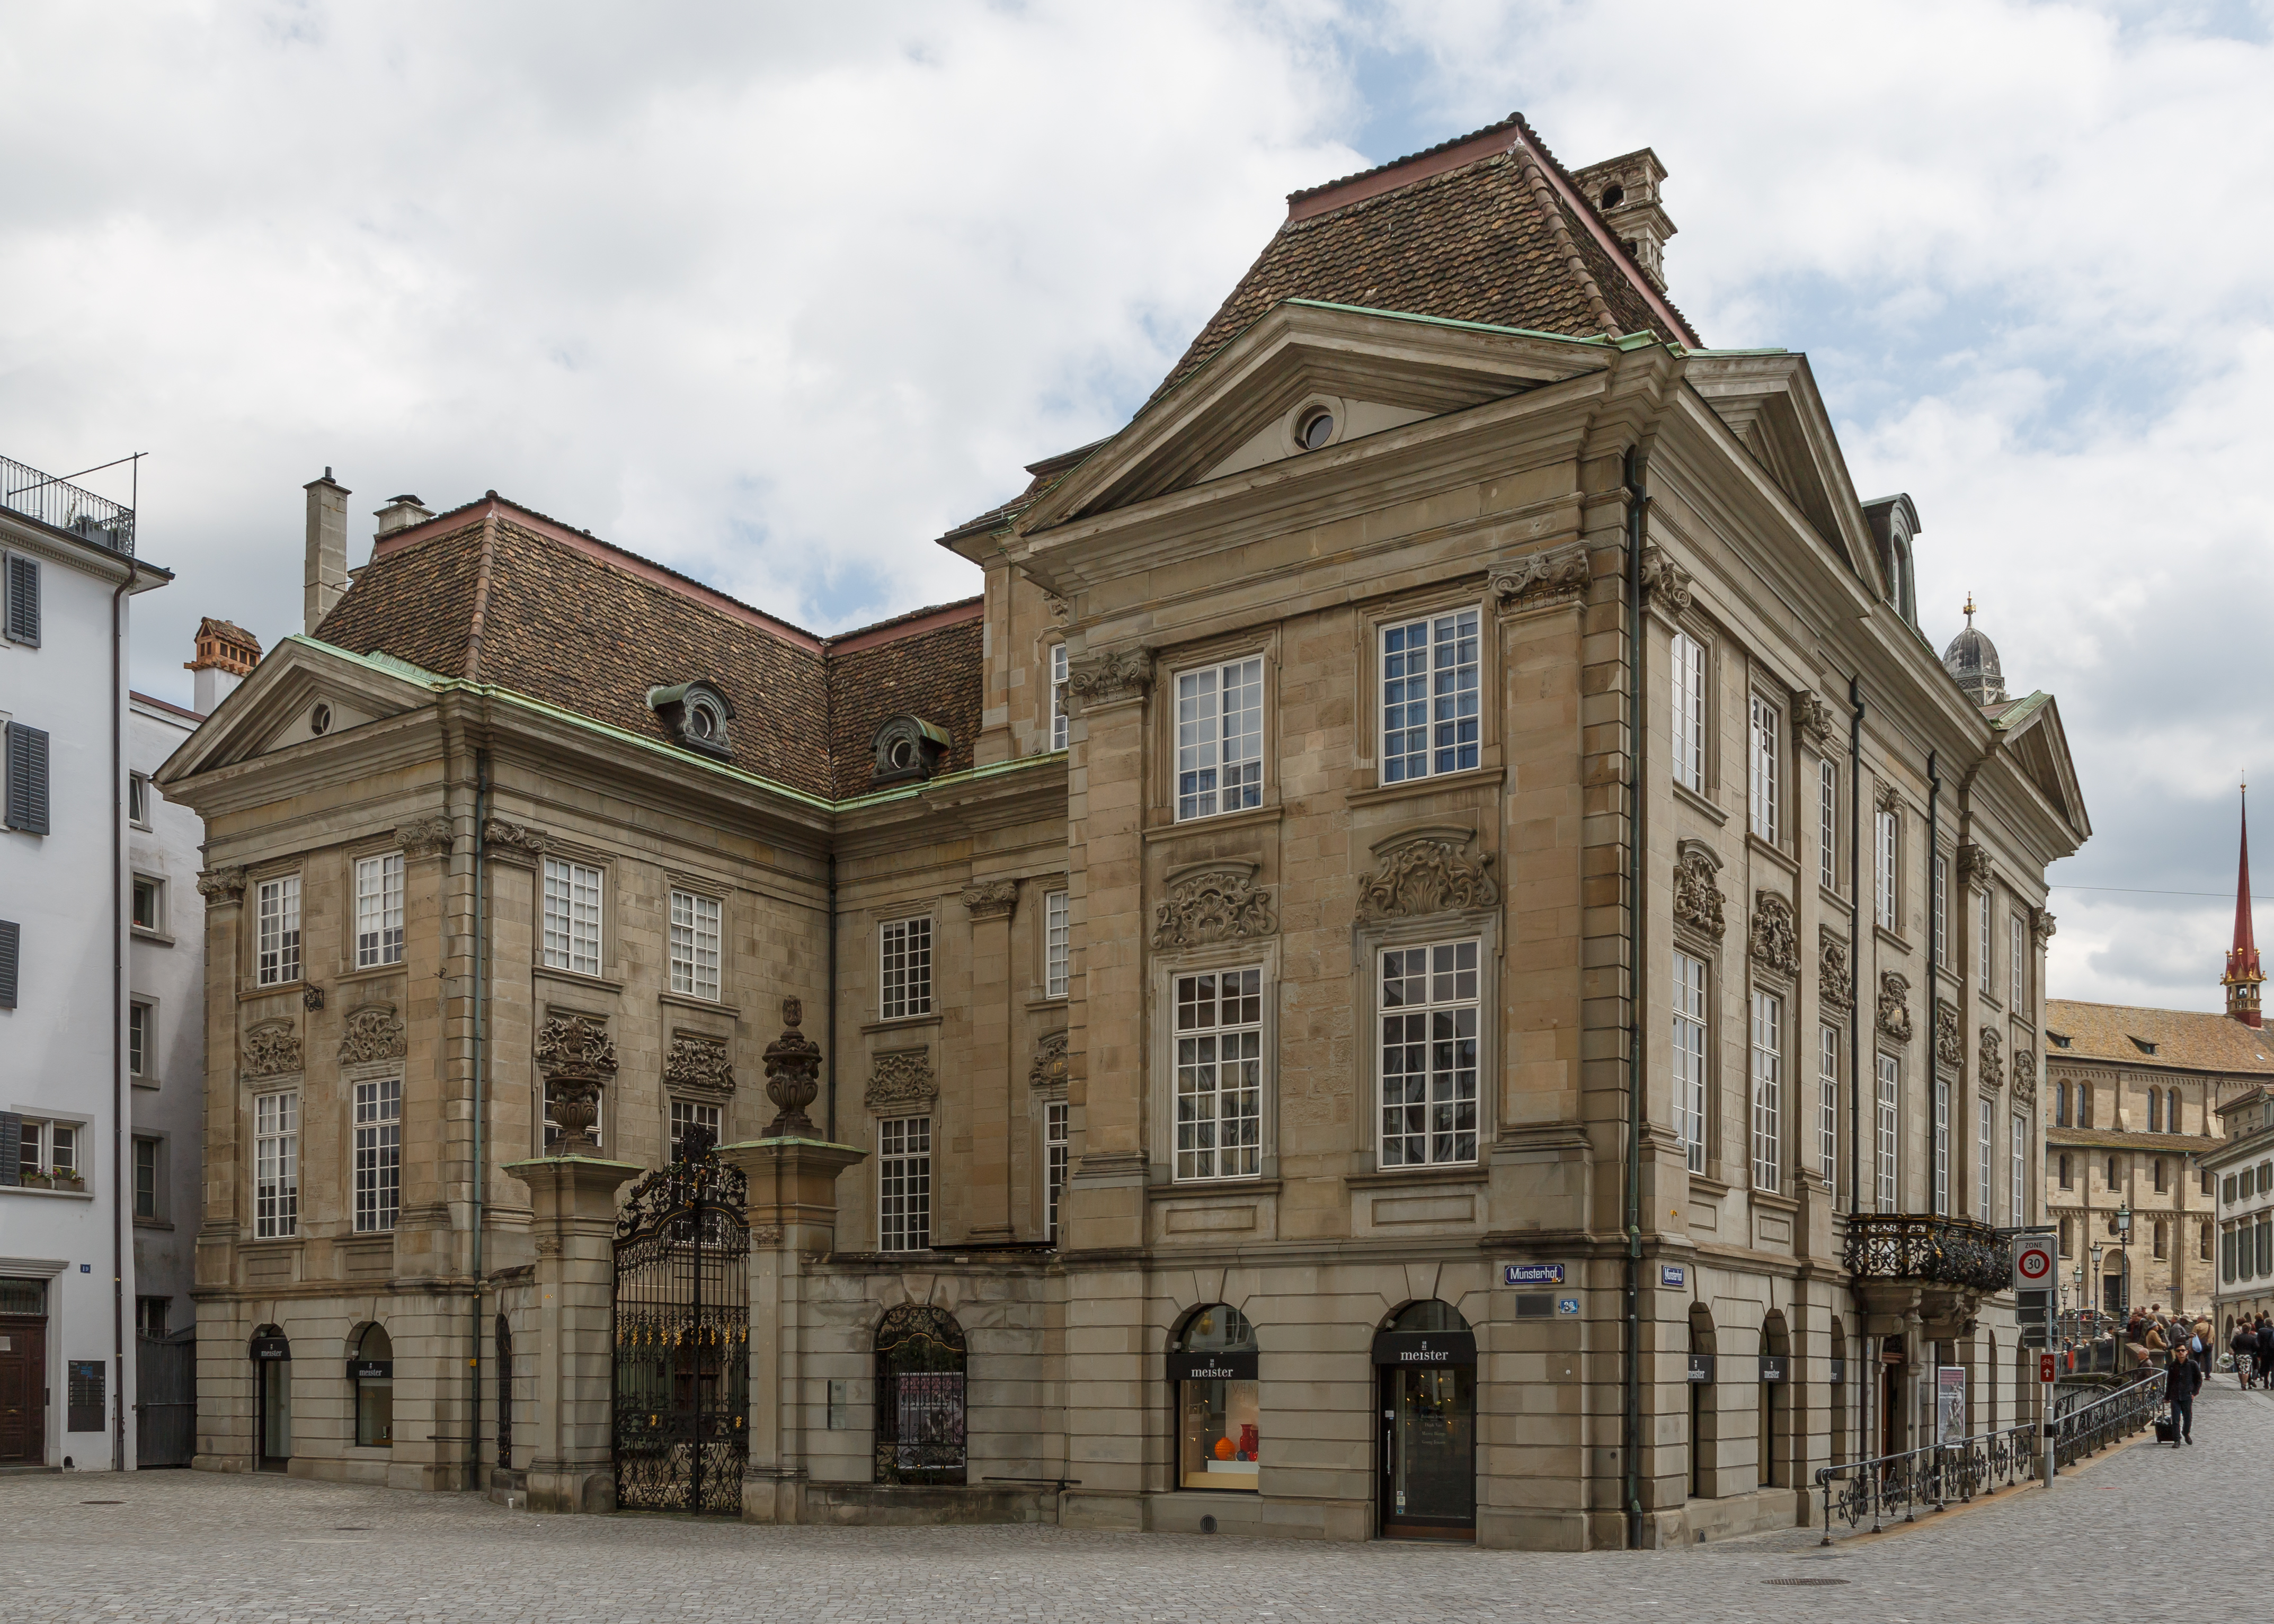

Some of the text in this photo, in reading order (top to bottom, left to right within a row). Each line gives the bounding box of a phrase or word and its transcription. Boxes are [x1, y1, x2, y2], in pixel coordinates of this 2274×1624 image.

[2027, 1258, 2040, 1269] 30
[1510, 1266, 1558, 1279] Münsterhof
[1400, 1350, 1449, 1360] meister
[1191, 1368, 1233, 1377] meister
[1764, 1369, 1780, 1378] meister
